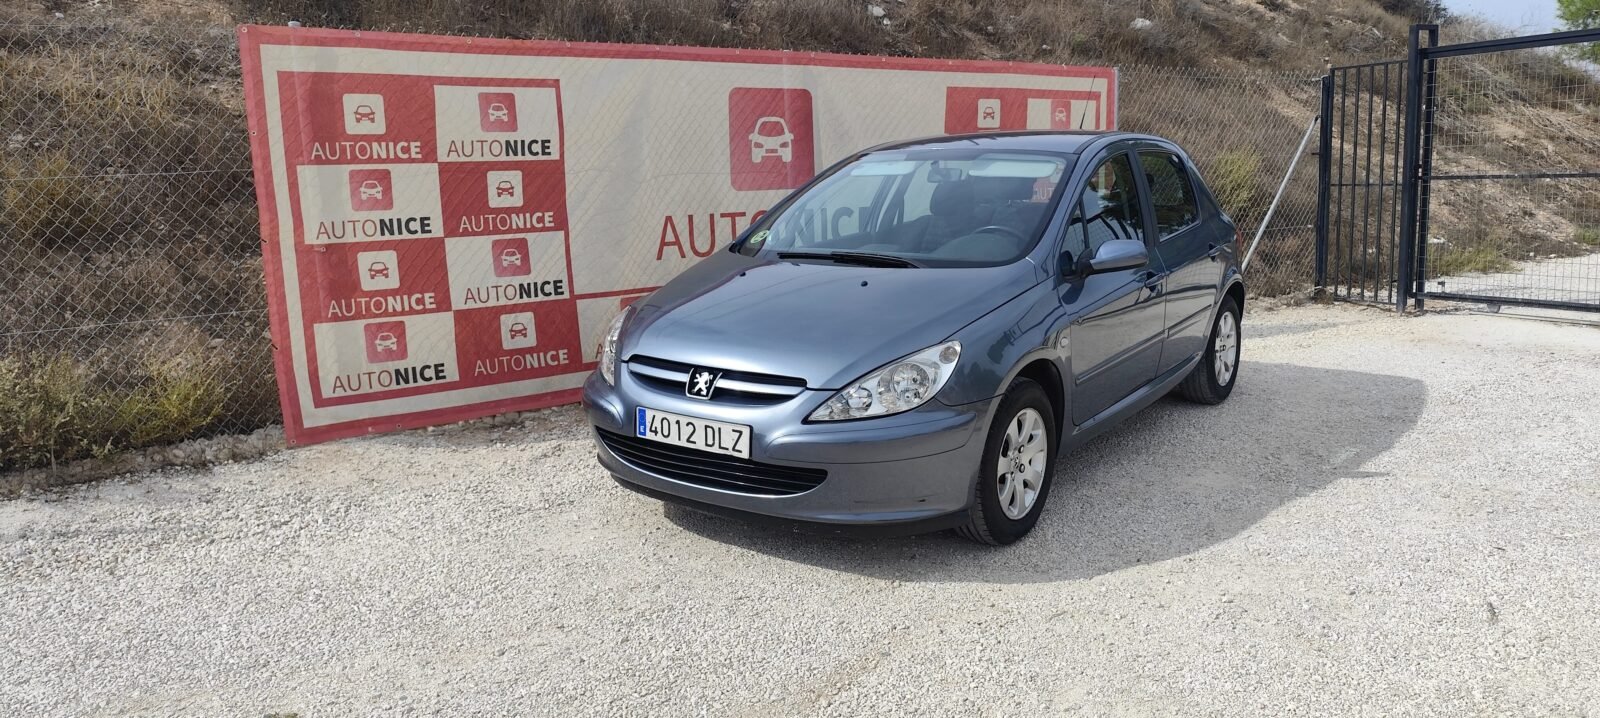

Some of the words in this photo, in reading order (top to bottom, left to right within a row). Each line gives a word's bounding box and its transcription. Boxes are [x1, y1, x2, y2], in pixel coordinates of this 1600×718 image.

[311, 141, 422, 161] AUTONICE
[447, 139, 552, 158] AUTONICE
[316, 216, 432, 240] AUTONICE
[459, 211, 555, 233] AUTONICE
[327, 292, 437, 318] AUTONICE
[464, 279, 565, 305] AUTONICE
[474, 349, 570, 376] AUTONICE
[332, 362, 447, 394] AUTONICE
[649, 414, 697, 445] 4012
[704, 424, 743, 454] DLZ
